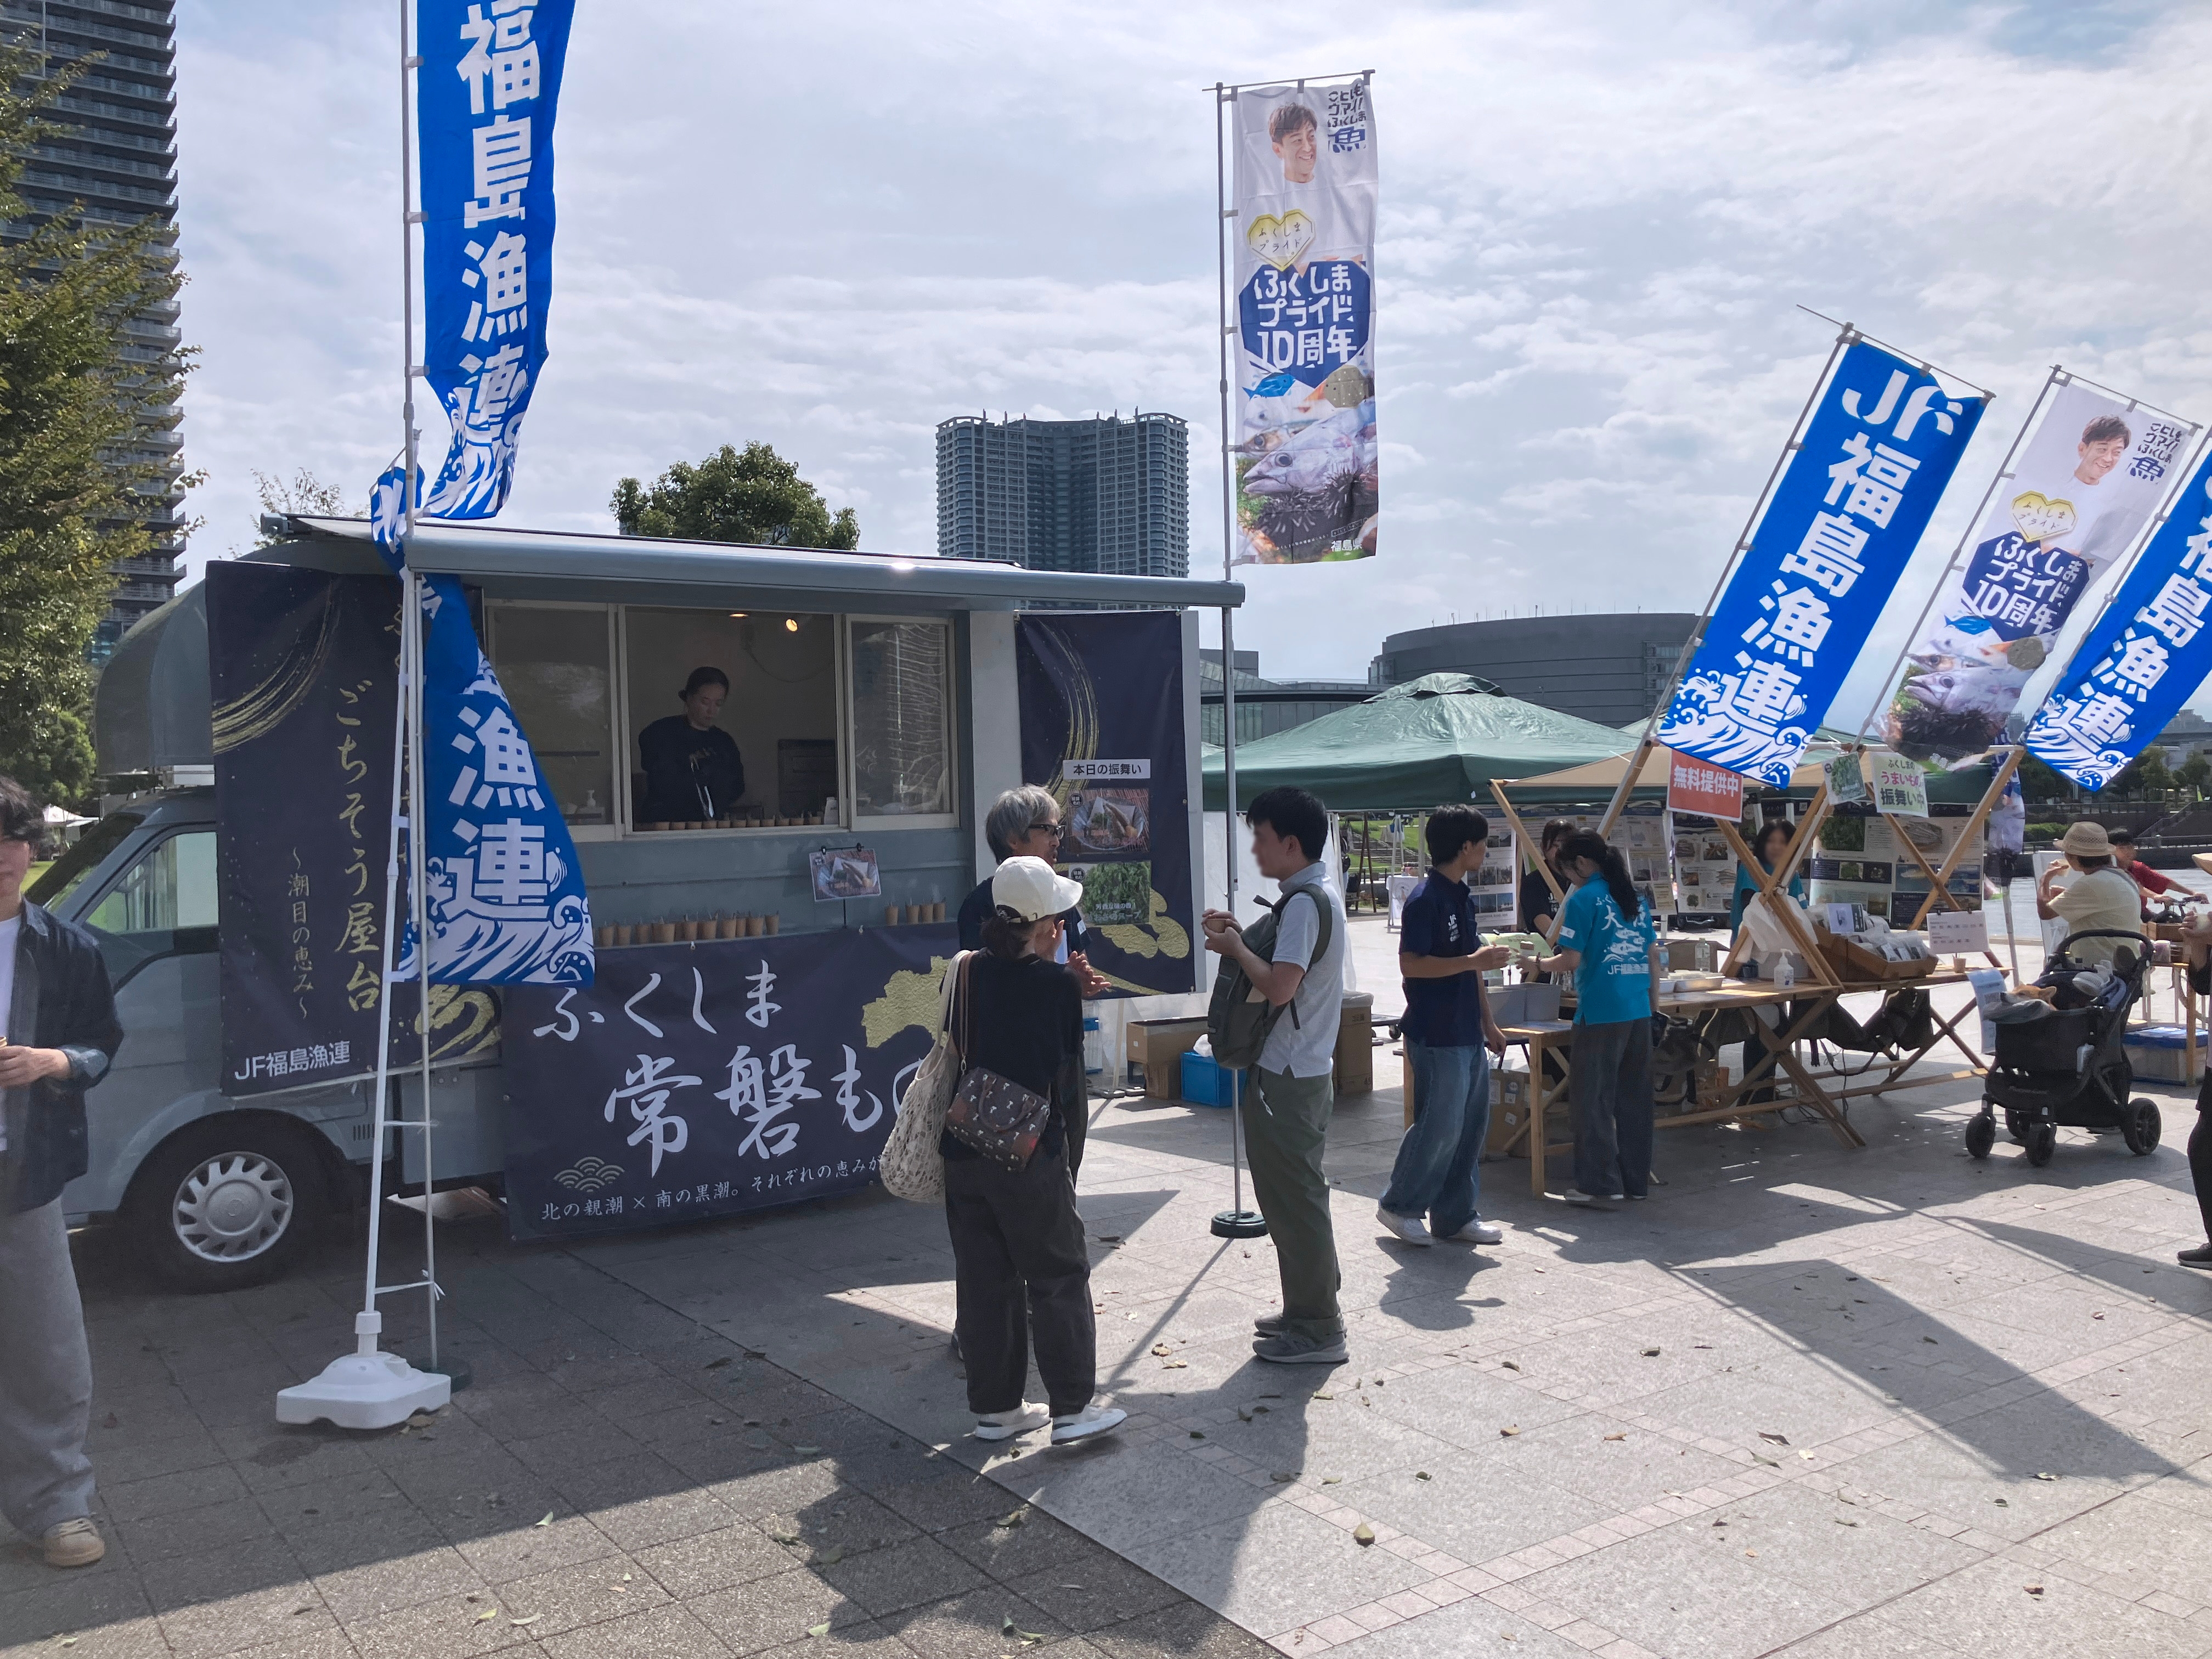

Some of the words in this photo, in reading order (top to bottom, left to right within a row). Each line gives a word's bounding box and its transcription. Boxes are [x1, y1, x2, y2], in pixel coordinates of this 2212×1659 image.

[1328, 126, 1366, 154] 魚
[1258, 221, 1302, 238] ふくしま
[1259, 238, 1302, 252] プライド
[1254, 264, 1352, 299] ふくしま
[1257, 295, 1354, 328] プライド
[1256, 324, 1357, 369] 10周年
[2130, 456, 2165, 482] 魚
[1995, 535, 2086, 585] ふくしま
[1985, 558, 2072, 607] プライド
[1973, 579, 2057, 636] 10周年
[1073, 763, 1142, 776] 本日の振舞い
[1673, 765, 1740, 798] 無料提供中
[335, 679, 383, 1012] ごちそう屋台
[533, 959, 782, 1042] ふくしま
[234, 1040, 351, 1081] JF福島漁連
[541, 1195, 623, 1221] 北の親潮
